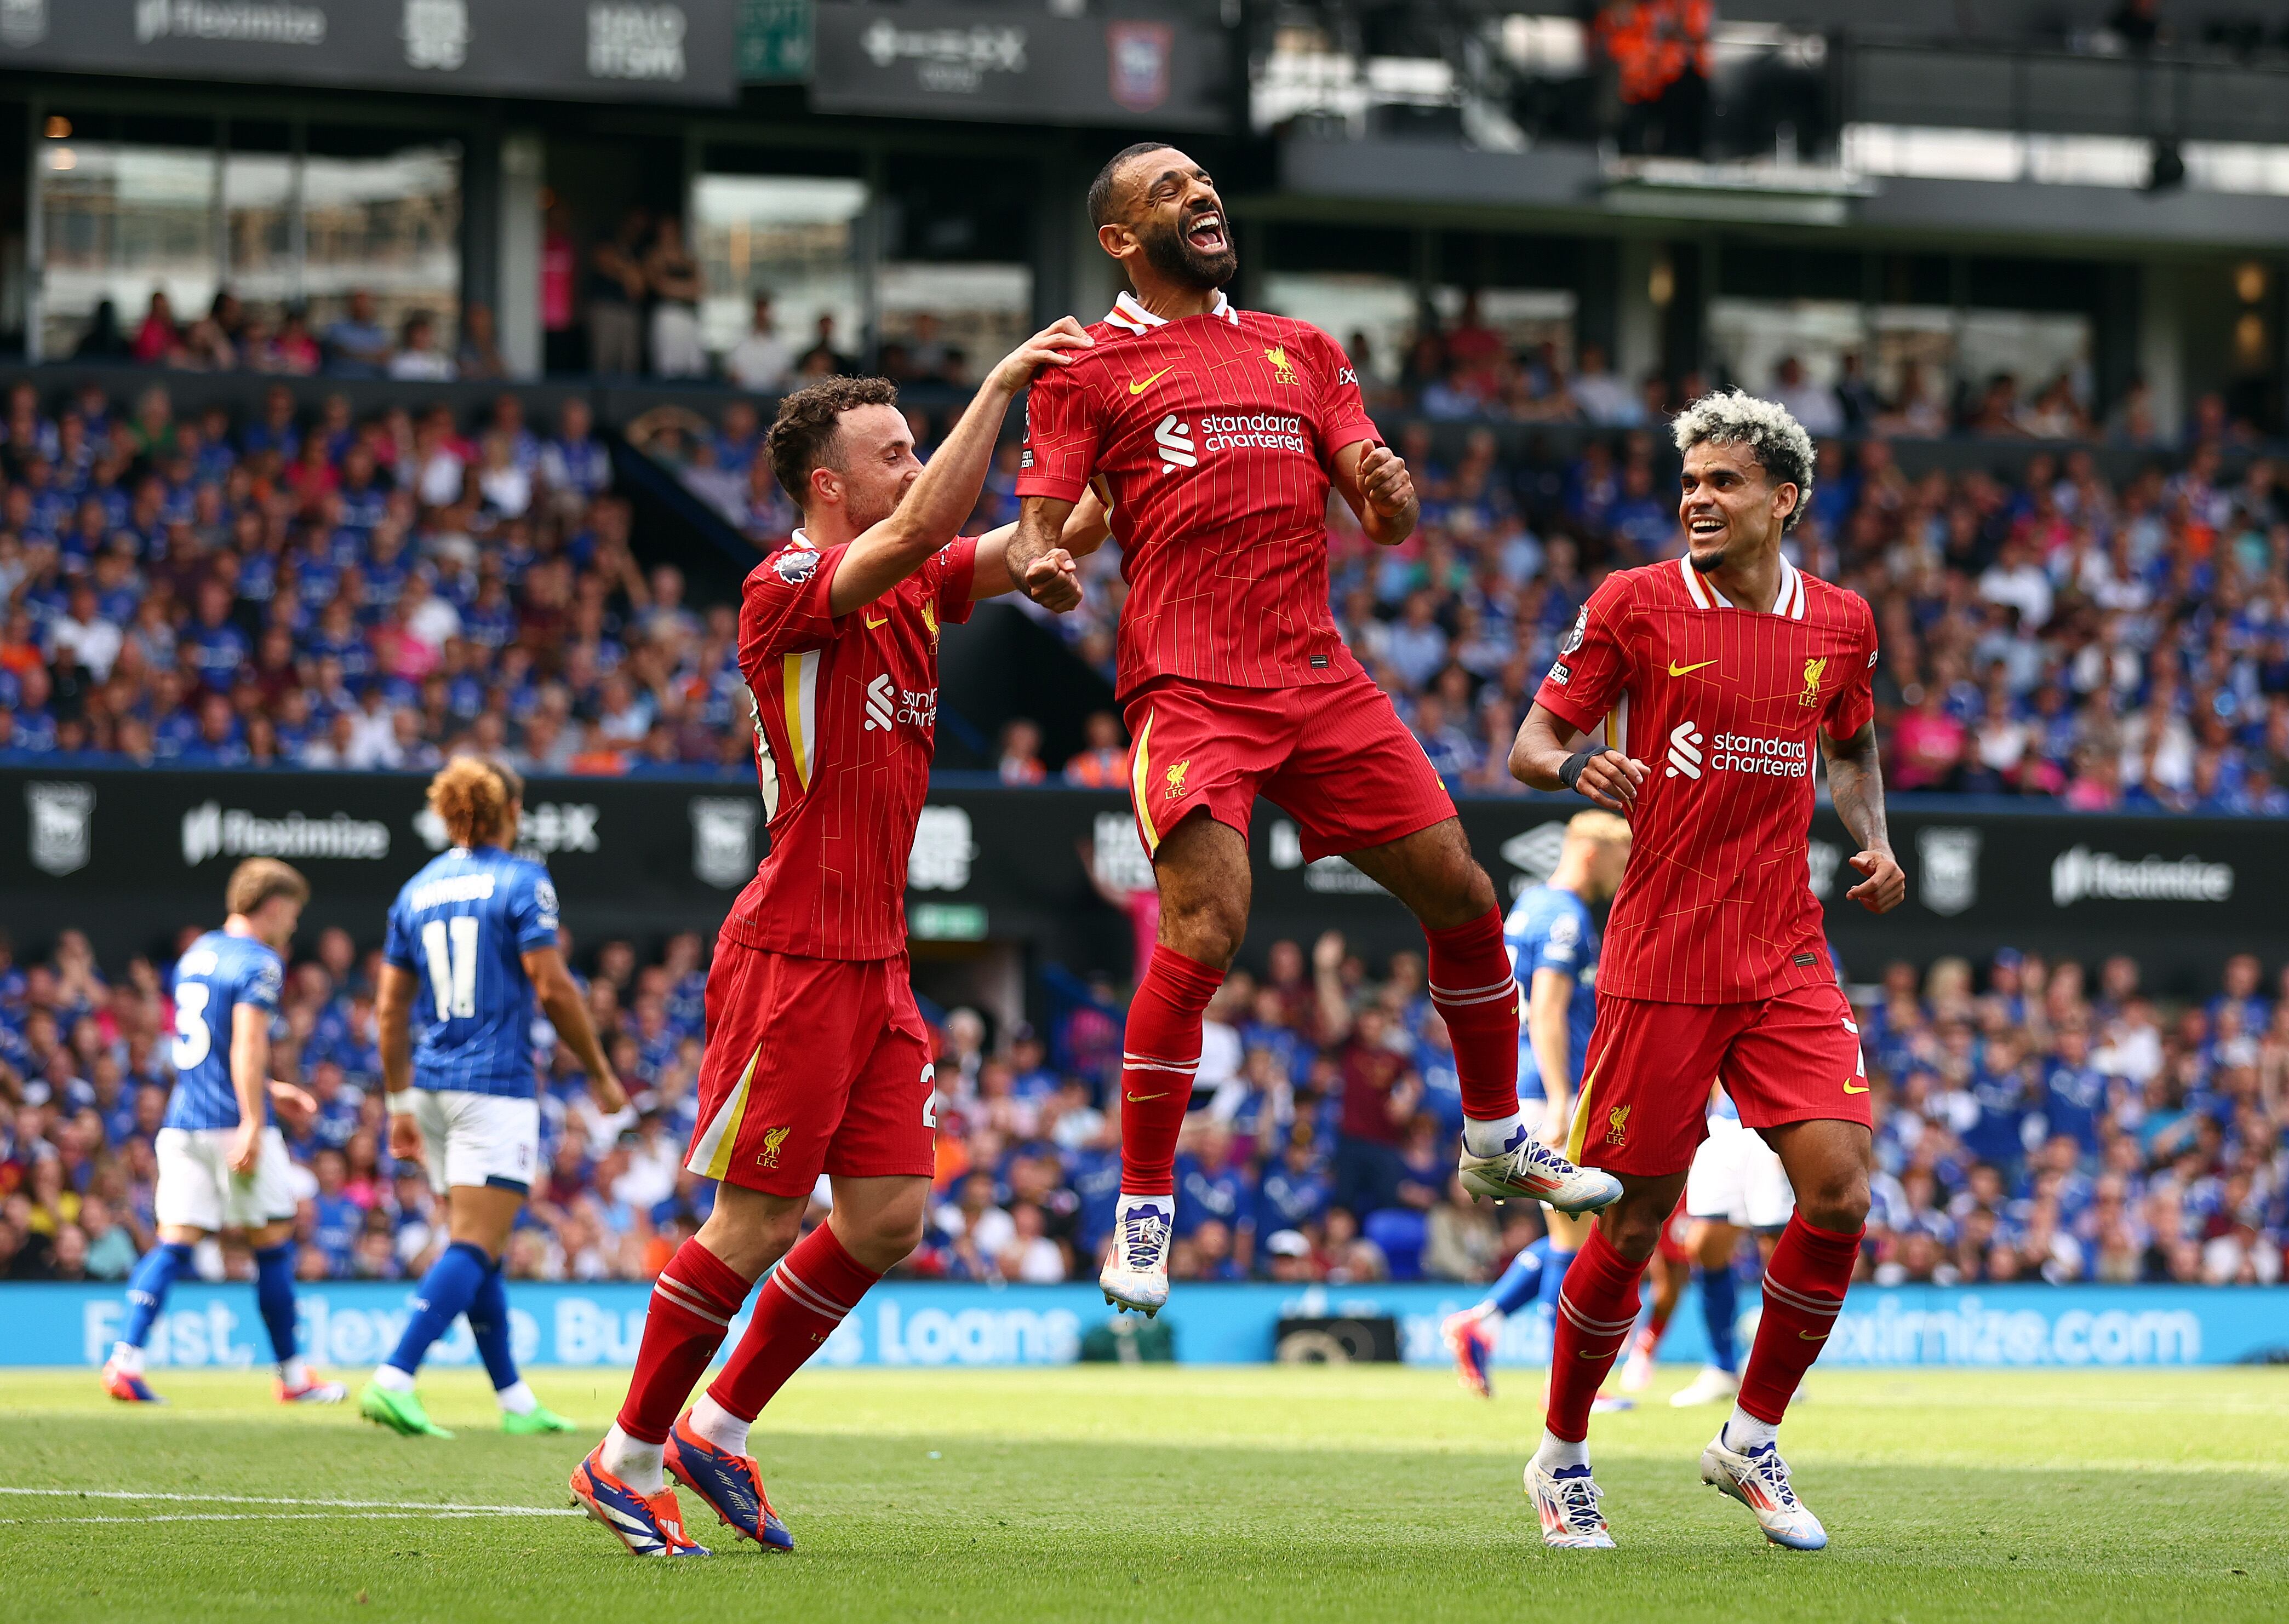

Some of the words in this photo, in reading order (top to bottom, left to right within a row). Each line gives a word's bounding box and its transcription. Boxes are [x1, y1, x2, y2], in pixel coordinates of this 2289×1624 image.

[1201, 412, 1301, 435] standard
[1205, 433, 1304, 454] chartered
[1713, 731, 1806, 759] standard
[1712, 751, 1807, 778] chartered
[421, 916, 479, 1023] 11
[172, 983, 211, 1071] 3
[879, 1298, 1081, 1363] Loans
